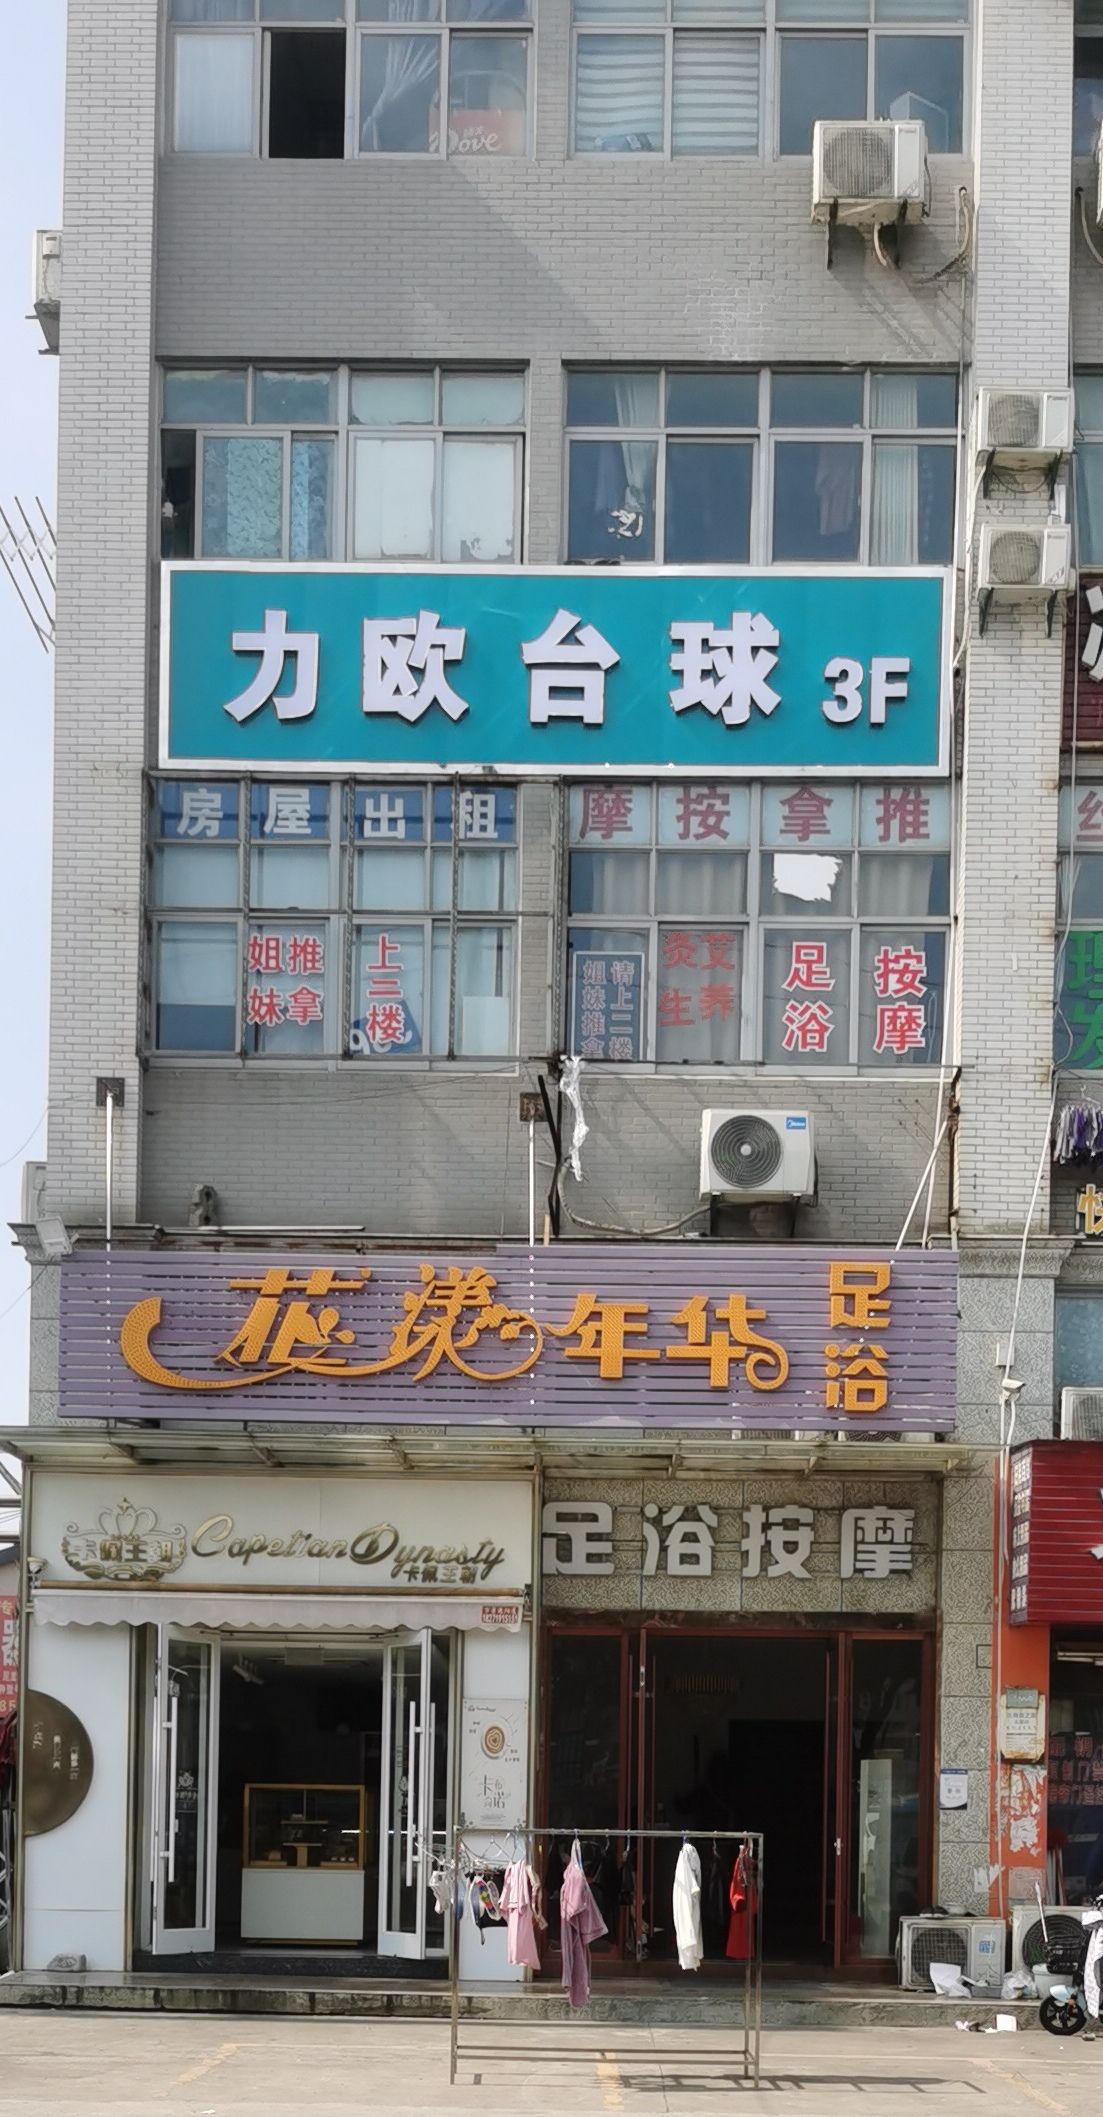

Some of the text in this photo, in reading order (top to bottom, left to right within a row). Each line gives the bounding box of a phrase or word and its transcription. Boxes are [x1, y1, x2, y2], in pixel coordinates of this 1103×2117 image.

[222, 608, 910, 727] 力欧台球 3F
[176, 787, 499, 839] 房屋出租
[366, 933, 405, 1045] 上二楼
[581, 960, 607, 1058] 姐妹推拿
[608, 960, 635, 1060] 请上二楼
[782, 941, 836, 1054] 足浴
[872, 945, 928, 1056] 按摩
[826, 1262, 892, 1412] 足浴
[191, 1513, 505, 1581] Capetian Dynasty
[542, 1501, 916, 1580] 足浴按摩
